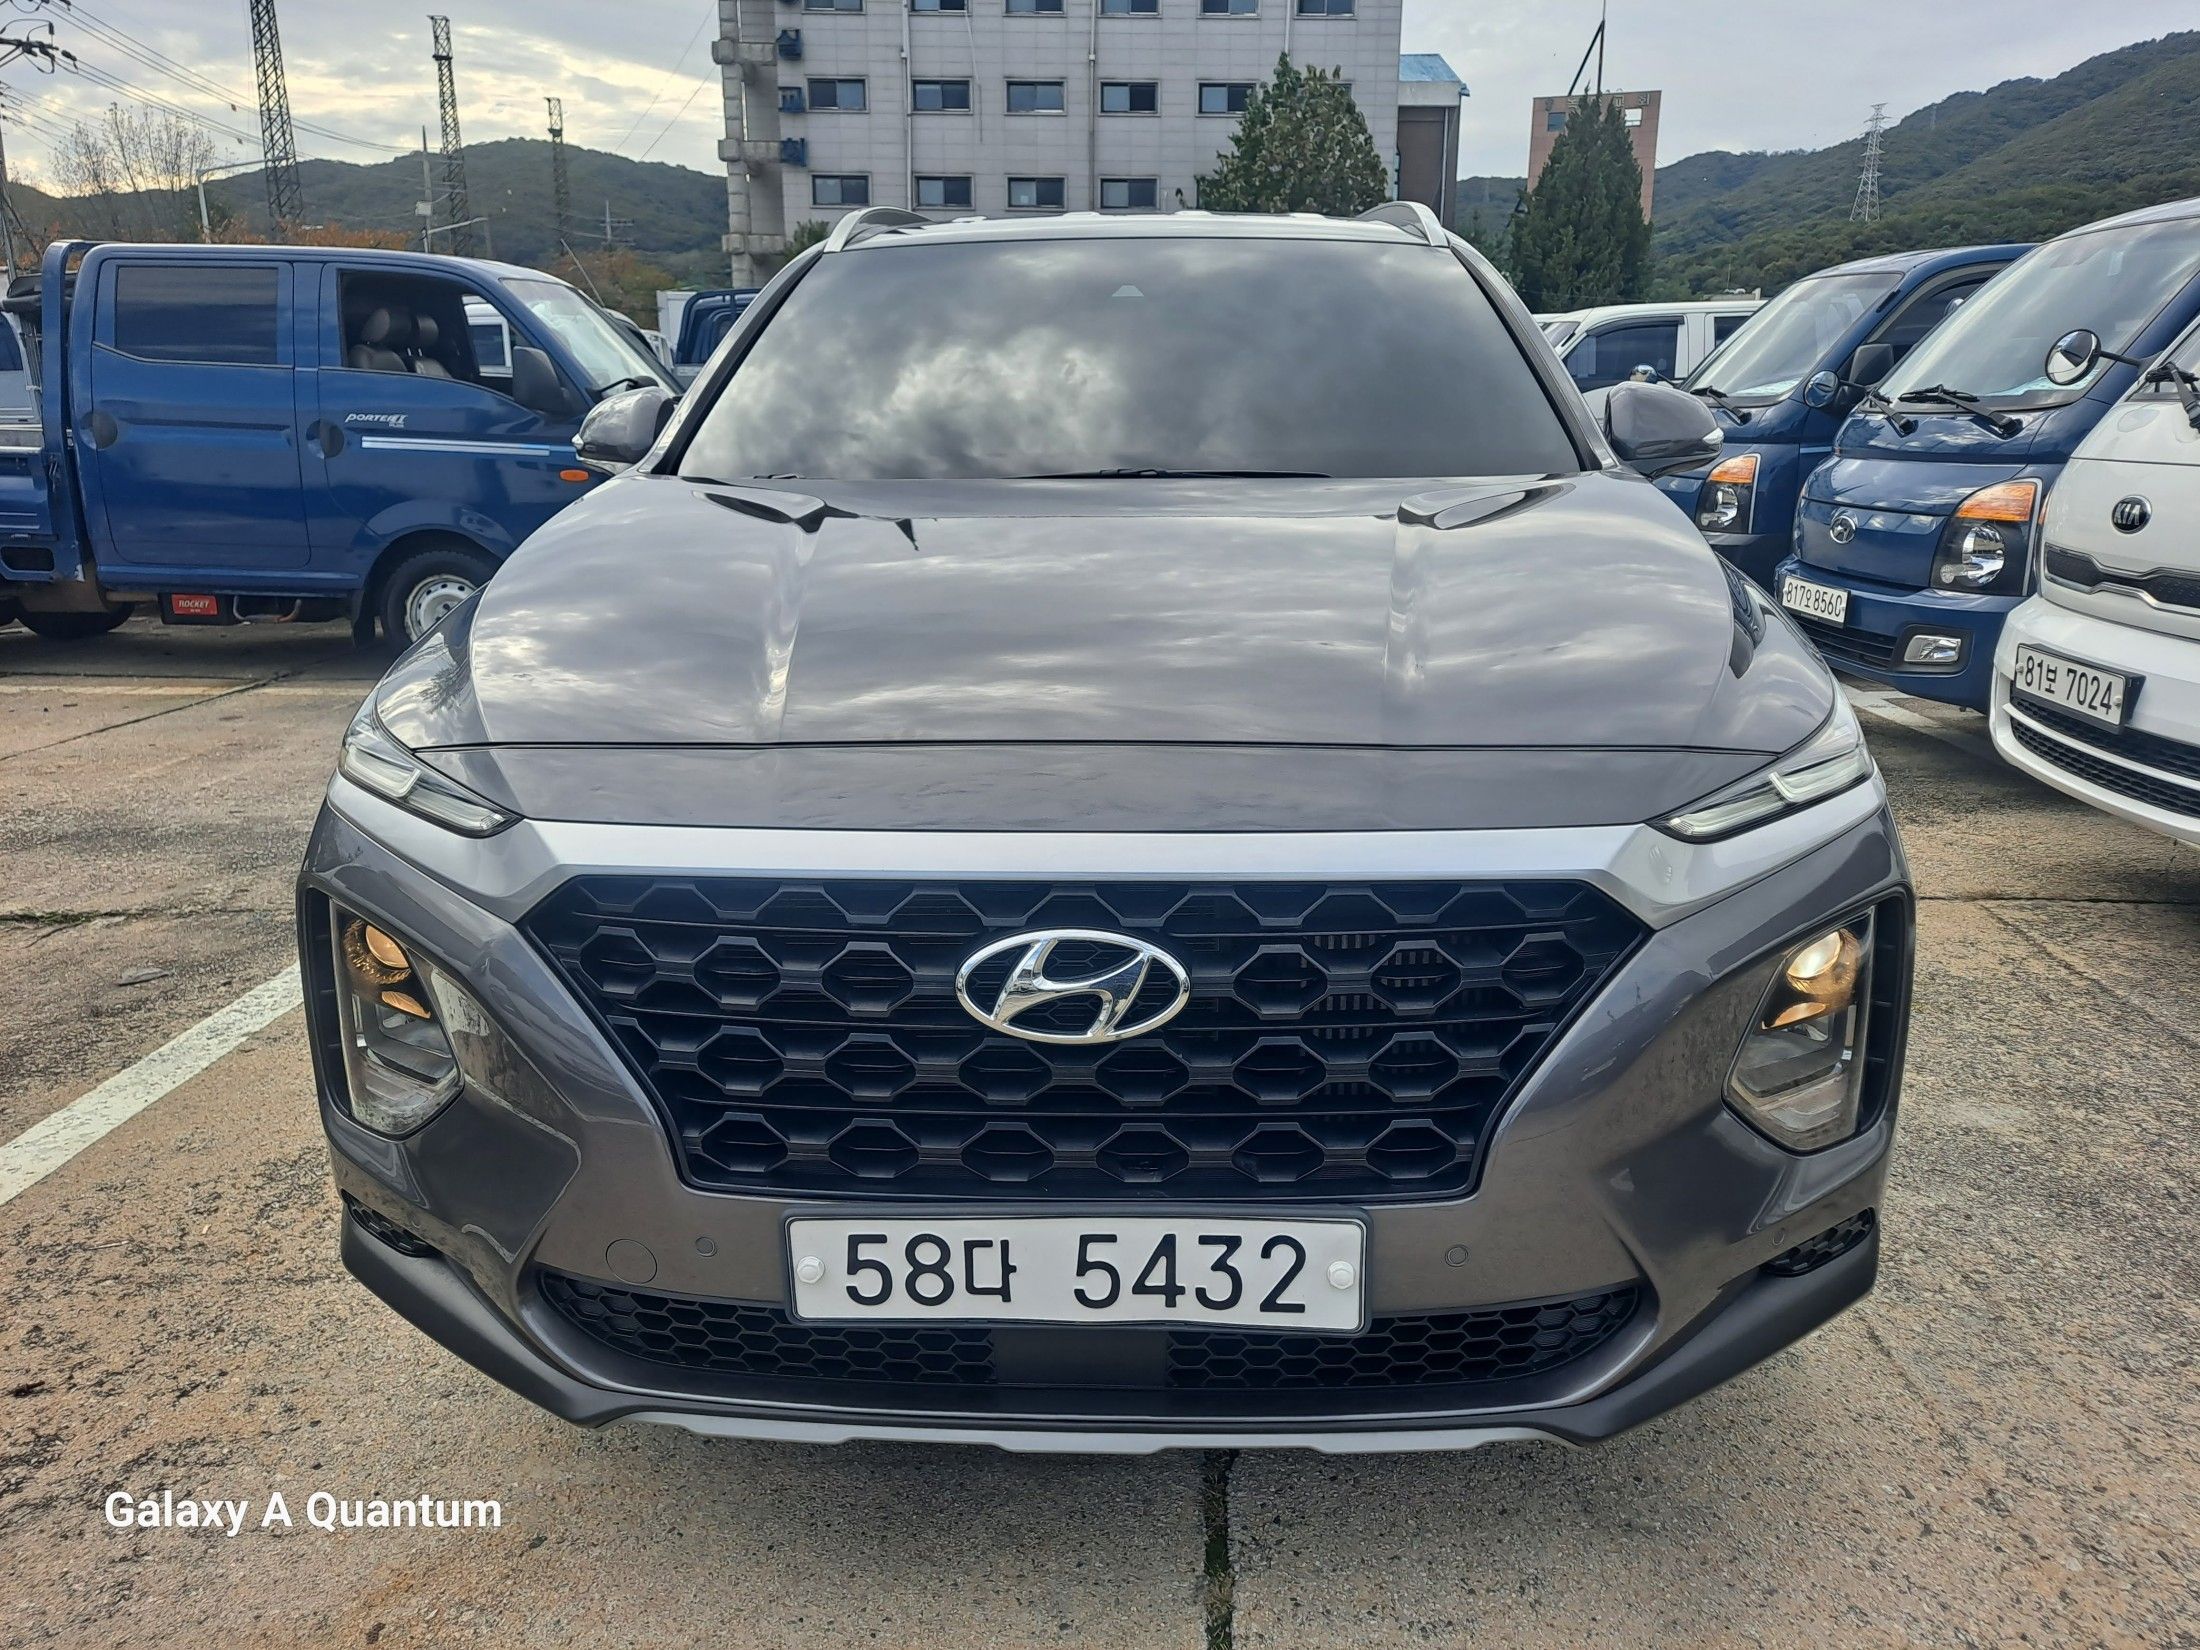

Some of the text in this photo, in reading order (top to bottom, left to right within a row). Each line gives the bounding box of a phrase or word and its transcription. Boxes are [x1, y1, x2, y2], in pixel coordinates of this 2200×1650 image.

[2113, 503, 2141, 526] KIA
[178, 599, 210, 609] ROCKET
[2025, 655, 2113, 715] 81보 7024
[846, 1233, 1307, 1314] 58다 5432
